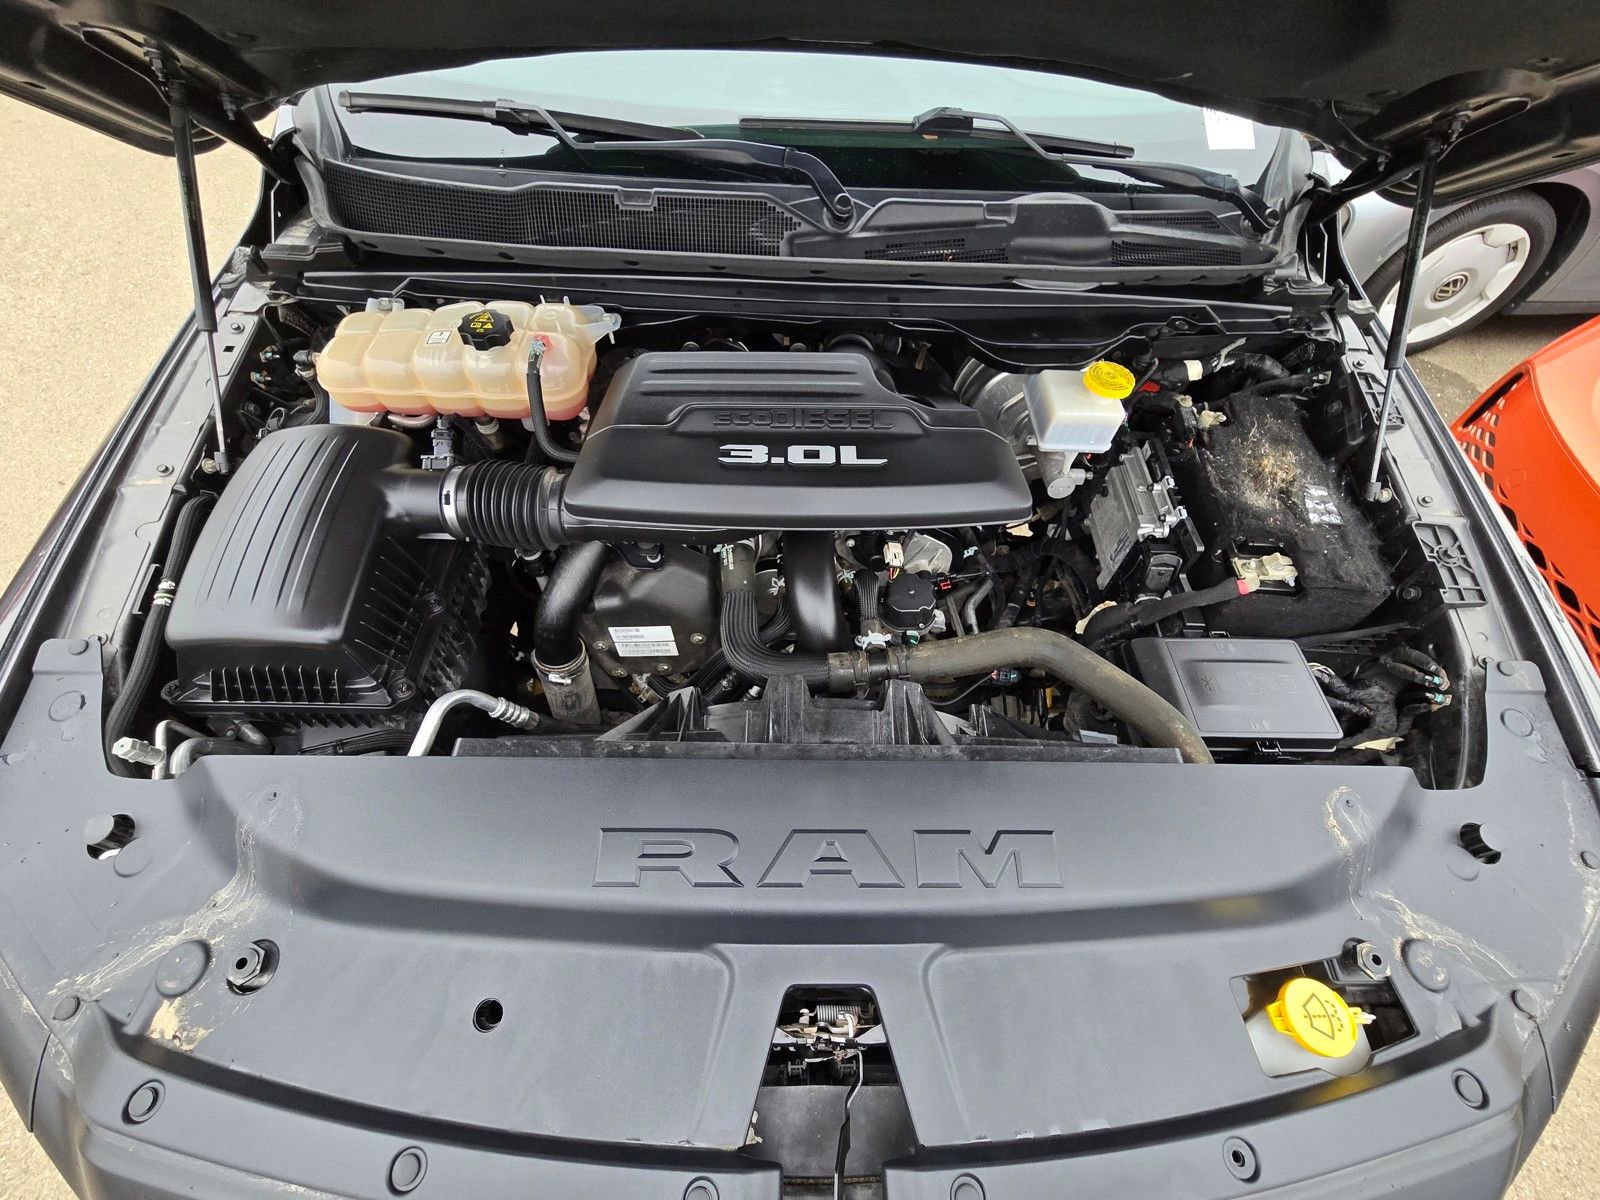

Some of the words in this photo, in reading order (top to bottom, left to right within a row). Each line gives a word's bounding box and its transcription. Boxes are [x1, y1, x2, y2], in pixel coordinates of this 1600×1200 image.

[713, 409, 895, 430] ECODIESEL
[718, 444, 888, 465] 3.0L
[592, 827, 1064, 889] RAM
